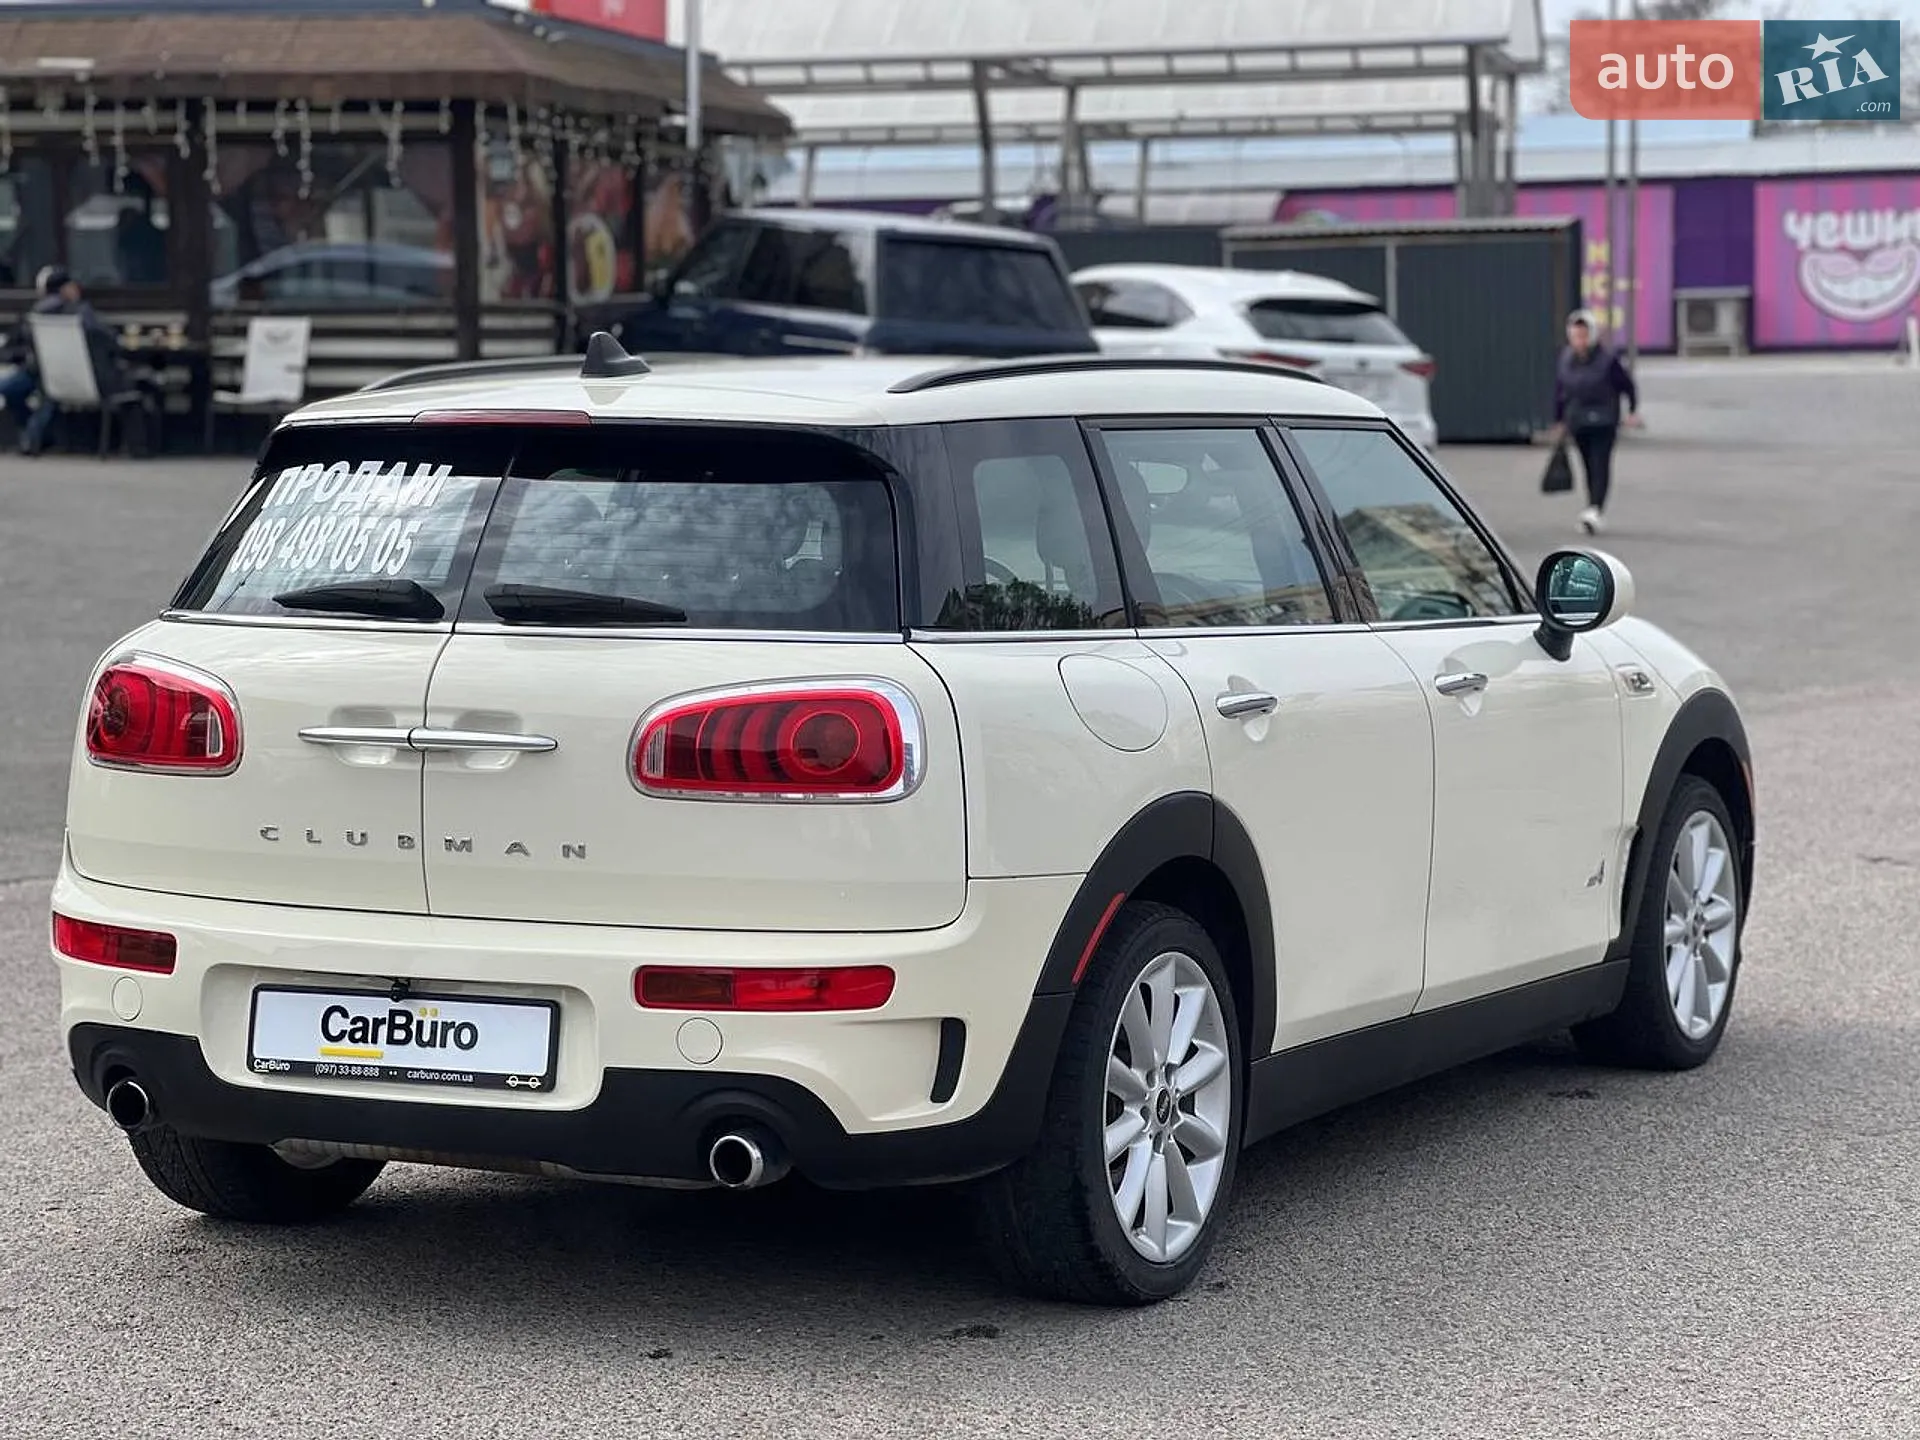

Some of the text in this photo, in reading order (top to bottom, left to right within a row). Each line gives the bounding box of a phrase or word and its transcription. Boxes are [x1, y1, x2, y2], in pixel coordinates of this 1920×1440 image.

[261, 460, 453, 512] ПРОДАМ
[229, 512, 424, 576] 098 498 05 05
[259, 824, 587, 860] CLUBMAN
[320, 1004, 479, 1051] CarBüro
[315, 1063, 380, 1078] (097) 33-88-888
[406, 1069, 474, 1083] carburo.com.ua
